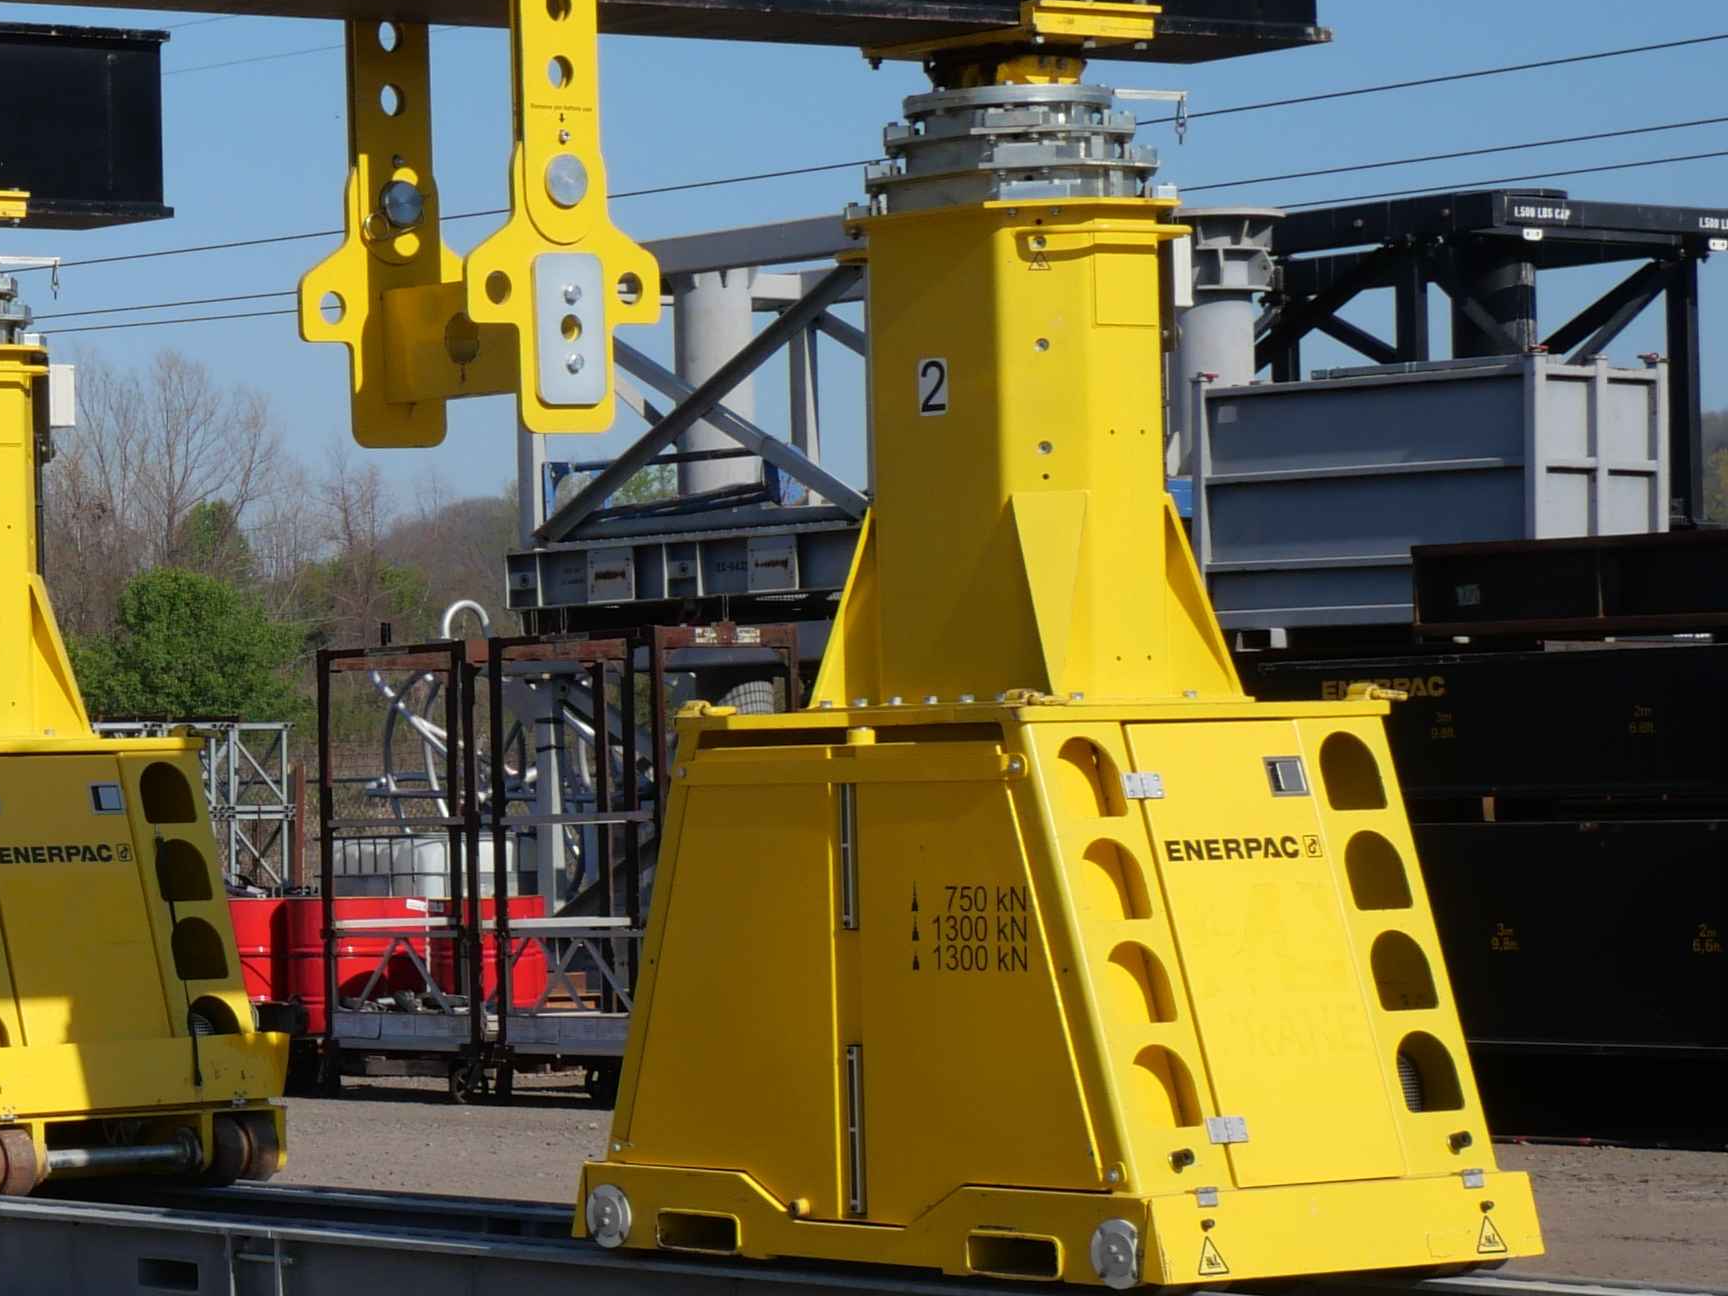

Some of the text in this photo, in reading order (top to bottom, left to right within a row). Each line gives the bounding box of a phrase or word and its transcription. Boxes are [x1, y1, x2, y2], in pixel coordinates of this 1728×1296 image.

[921, 360, 946, 412] 2
[1165, 837, 1299, 861] ENERPAC
[945, 886, 1027, 912] 750 kN
[932, 915, 1028, 942] 1300 kN
[933, 945, 1028, 972] 1300 kN
